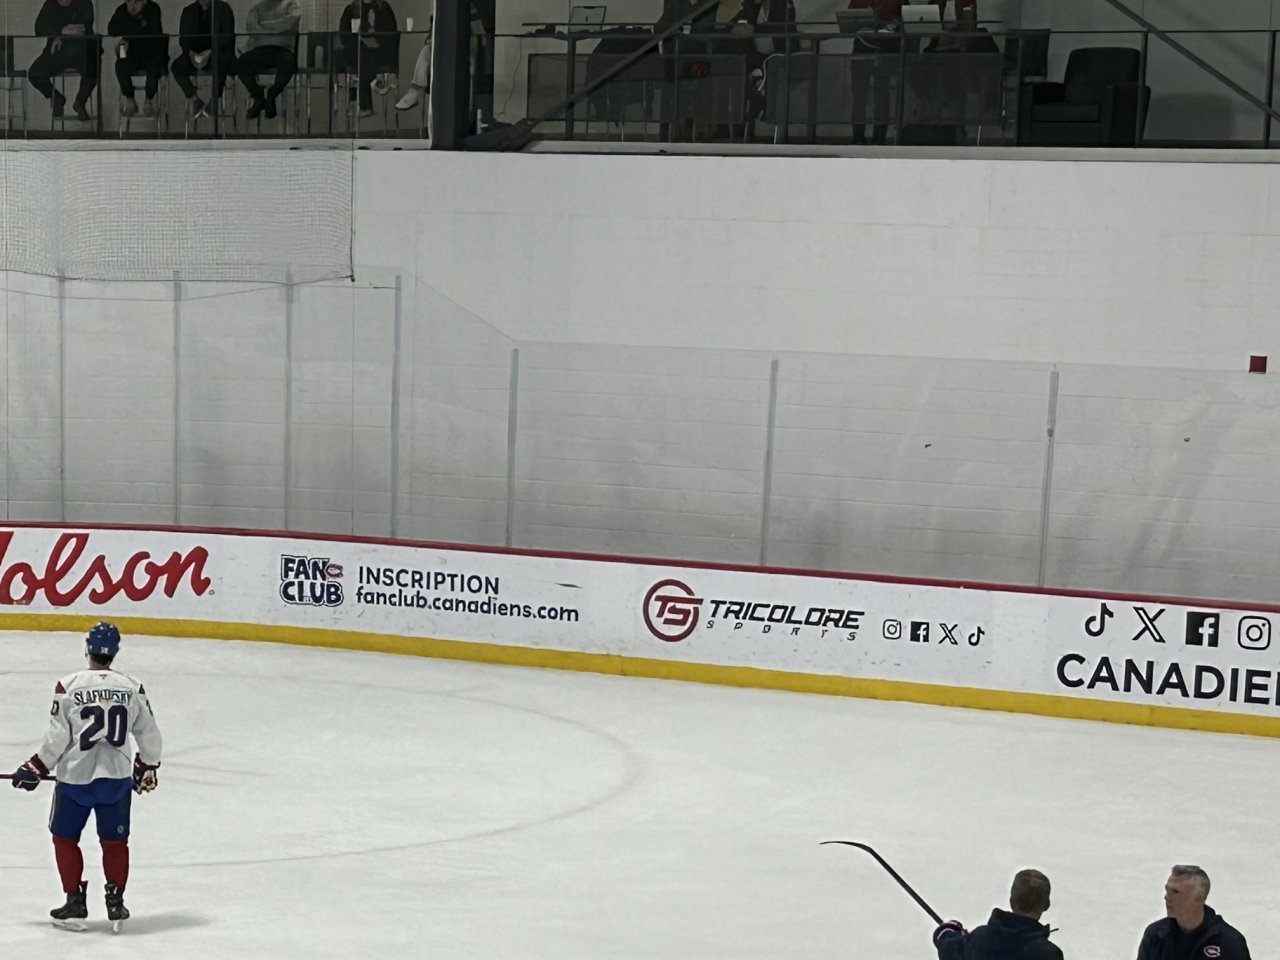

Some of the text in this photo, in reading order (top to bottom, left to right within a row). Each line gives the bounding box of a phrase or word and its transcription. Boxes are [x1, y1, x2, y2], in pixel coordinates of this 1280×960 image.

[281, 555, 328, 581] FAN
[358, 566, 500, 595] INSCRIPTION
[281, 580, 343, 606] CLUB
[355, 585, 580, 622] fanclub.canadiens.com
[709, 599, 865, 630] TRICOLORE
[1056, 653, 1280, 707] CANADIE
[79, 704, 128, 752] 20
